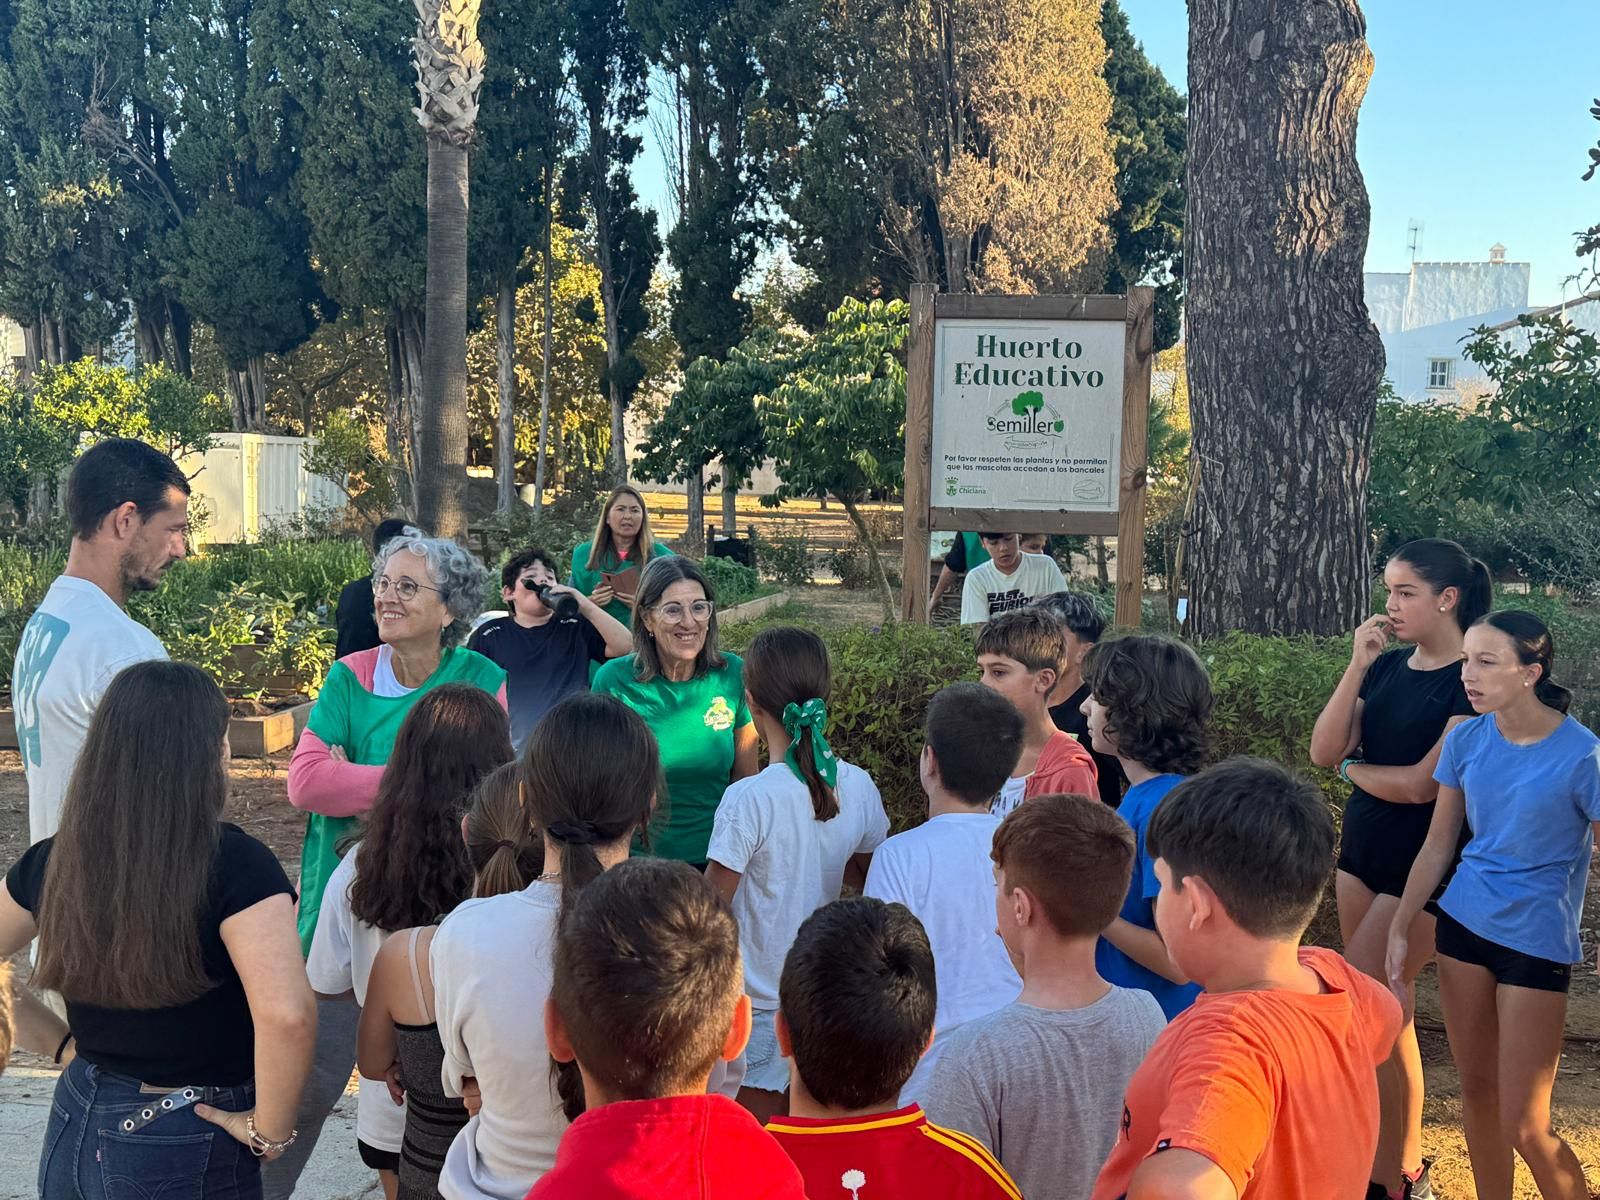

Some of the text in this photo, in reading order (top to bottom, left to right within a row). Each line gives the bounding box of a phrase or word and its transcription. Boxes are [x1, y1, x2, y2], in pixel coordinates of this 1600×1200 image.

[976, 334, 1083, 359] Huerto
[953, 361, 1104, 388] Educativo
[986, 411, 1064, 433] Semillero
[947, 464, 961, 472] que
[979, 456, 1011, 464] respeten
[1025, 457, 1053, 465] plantas
[1073, 458, 1107, 466] permitan
